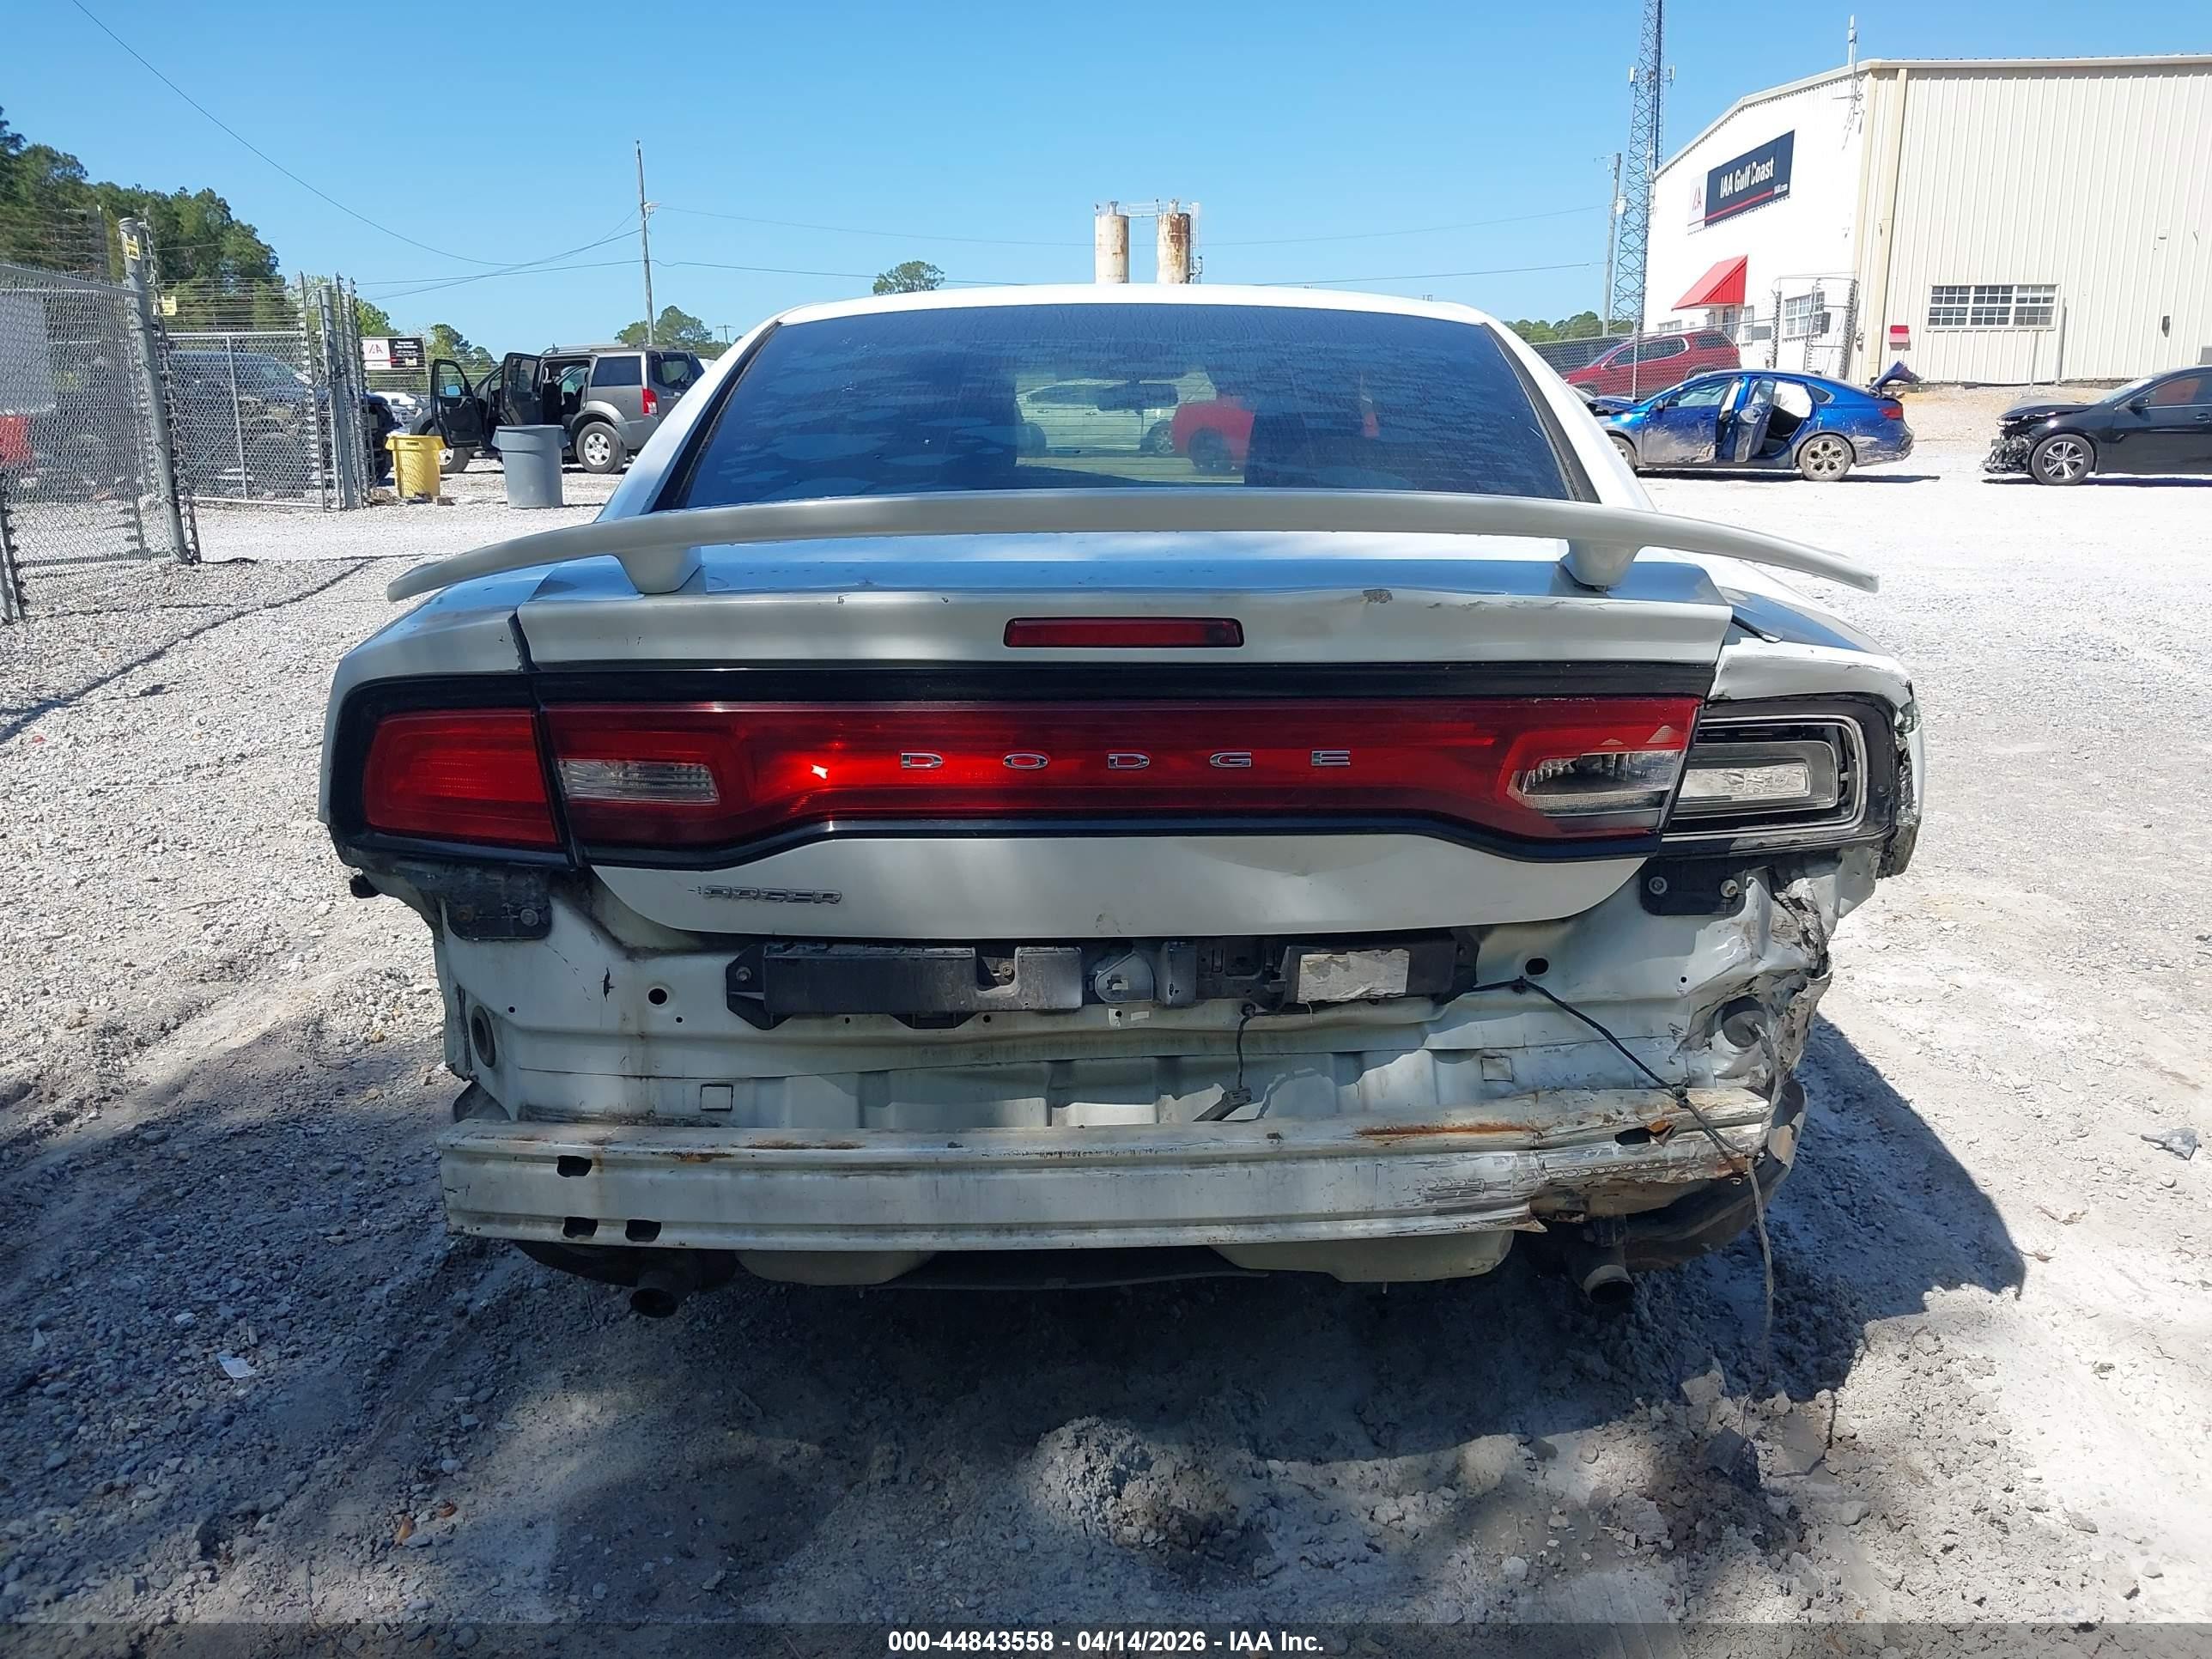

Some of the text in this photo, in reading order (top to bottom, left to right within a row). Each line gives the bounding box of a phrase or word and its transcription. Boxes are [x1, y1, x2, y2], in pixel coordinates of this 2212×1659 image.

[1719, 155, 1774, 199] IAA Gulf Coast
[900, 749, 1352, 769] DODGE
